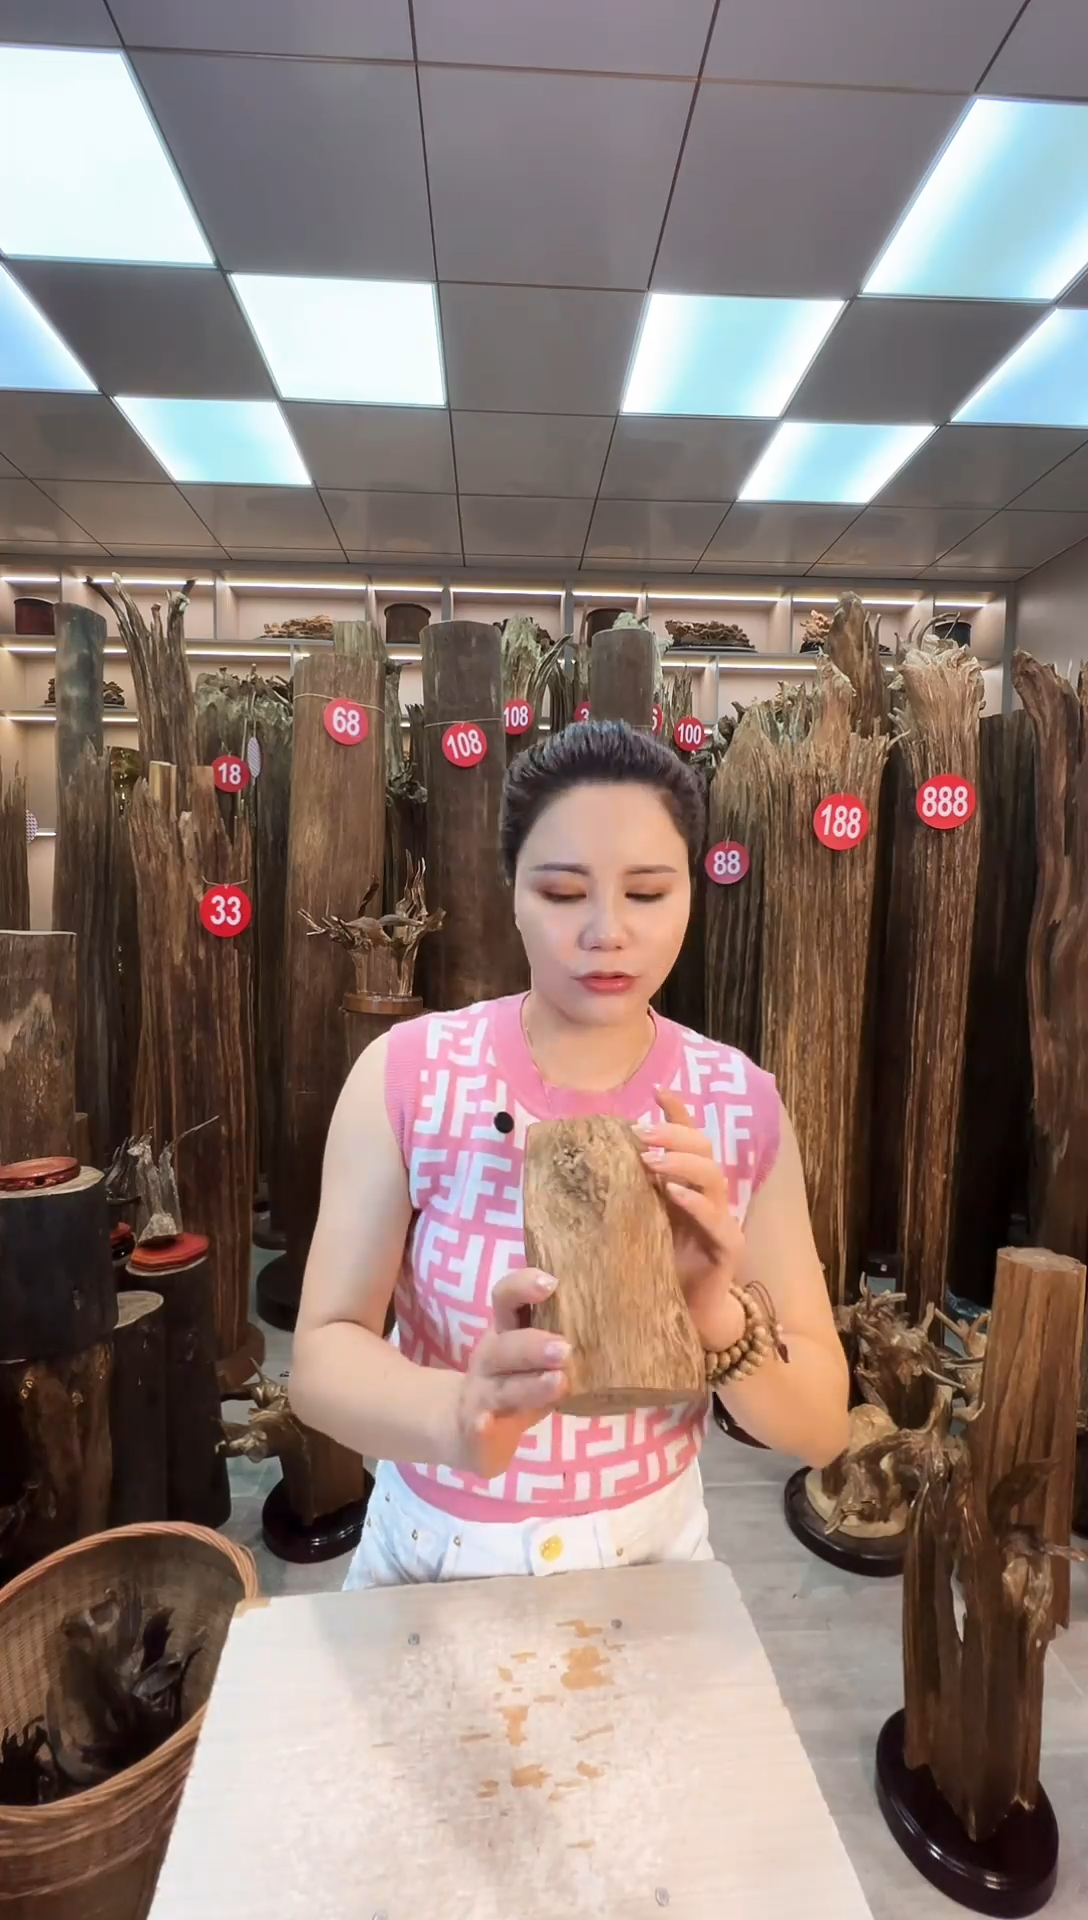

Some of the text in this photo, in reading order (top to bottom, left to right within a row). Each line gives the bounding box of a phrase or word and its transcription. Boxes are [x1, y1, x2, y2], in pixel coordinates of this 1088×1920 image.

[332, 706, 360, 736] 68
[504, 705, 528, 727] 108
[446, 729, 482, 759] 108
[678, 723, 702, 744] 100
[218, 763, 241, 785] 18
[922, 786, 968, 817] 888
[821, 804, 862, 839] 188
[713, 850, 741, 875] 88
[210, 895, 241, 926] 33
